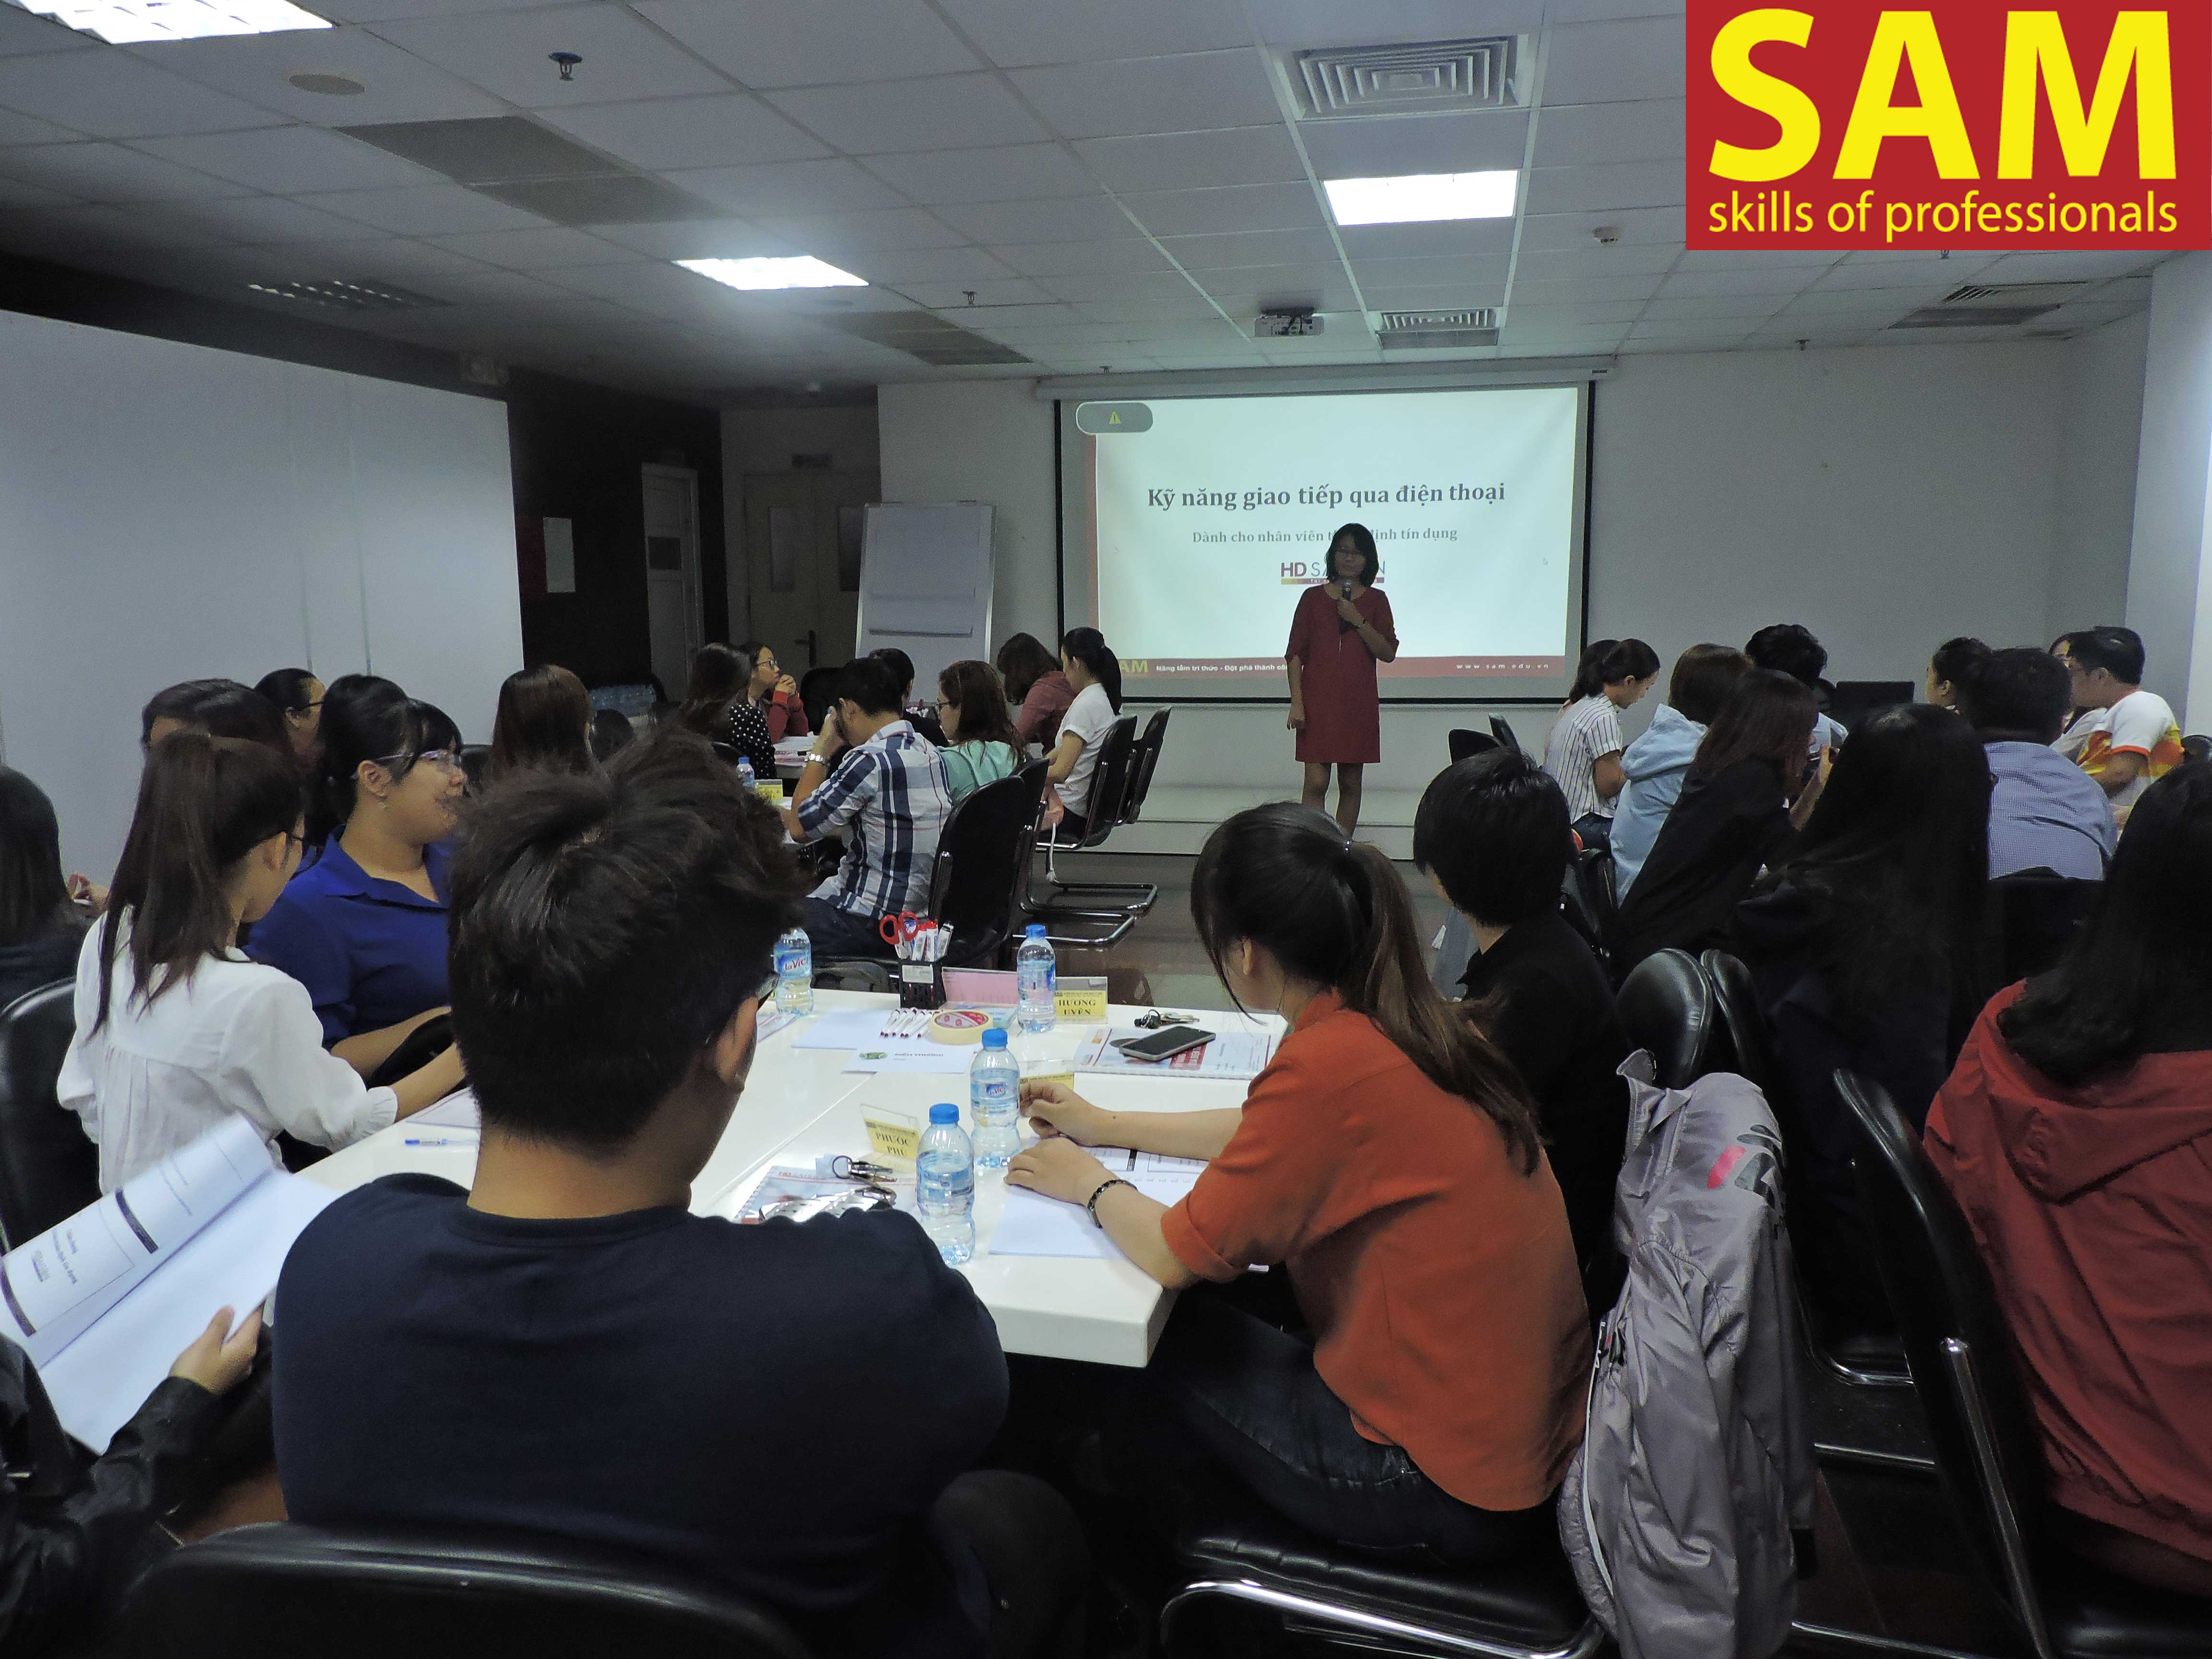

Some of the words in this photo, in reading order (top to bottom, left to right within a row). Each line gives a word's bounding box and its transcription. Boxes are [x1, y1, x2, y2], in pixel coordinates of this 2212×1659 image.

[1148, 488, 1176, 511] Kỹ
[1182, 487, 1237, 511] năng
[1242, 487, 1291, 510] giao
[1298, 483, 1343, 509] tiếp
[1349, 489, 1390, 508] qua
[1395, 484, 1443, 506] điện
[1449, 482, 1505, 505] thoại
[1192, 531, 1227, 542] Dành
[1231, 531, 1255, 542] cho
[1258, 530, 1291, 542] nhân
[1295, 530, 1324, 541] viên
[1401, 528, 1419, 540] tín
[1422, 528, 1458, 541] dụng
[1281, 562, 1307, 577] HD
[1120, 660, 1148, 673] AM
